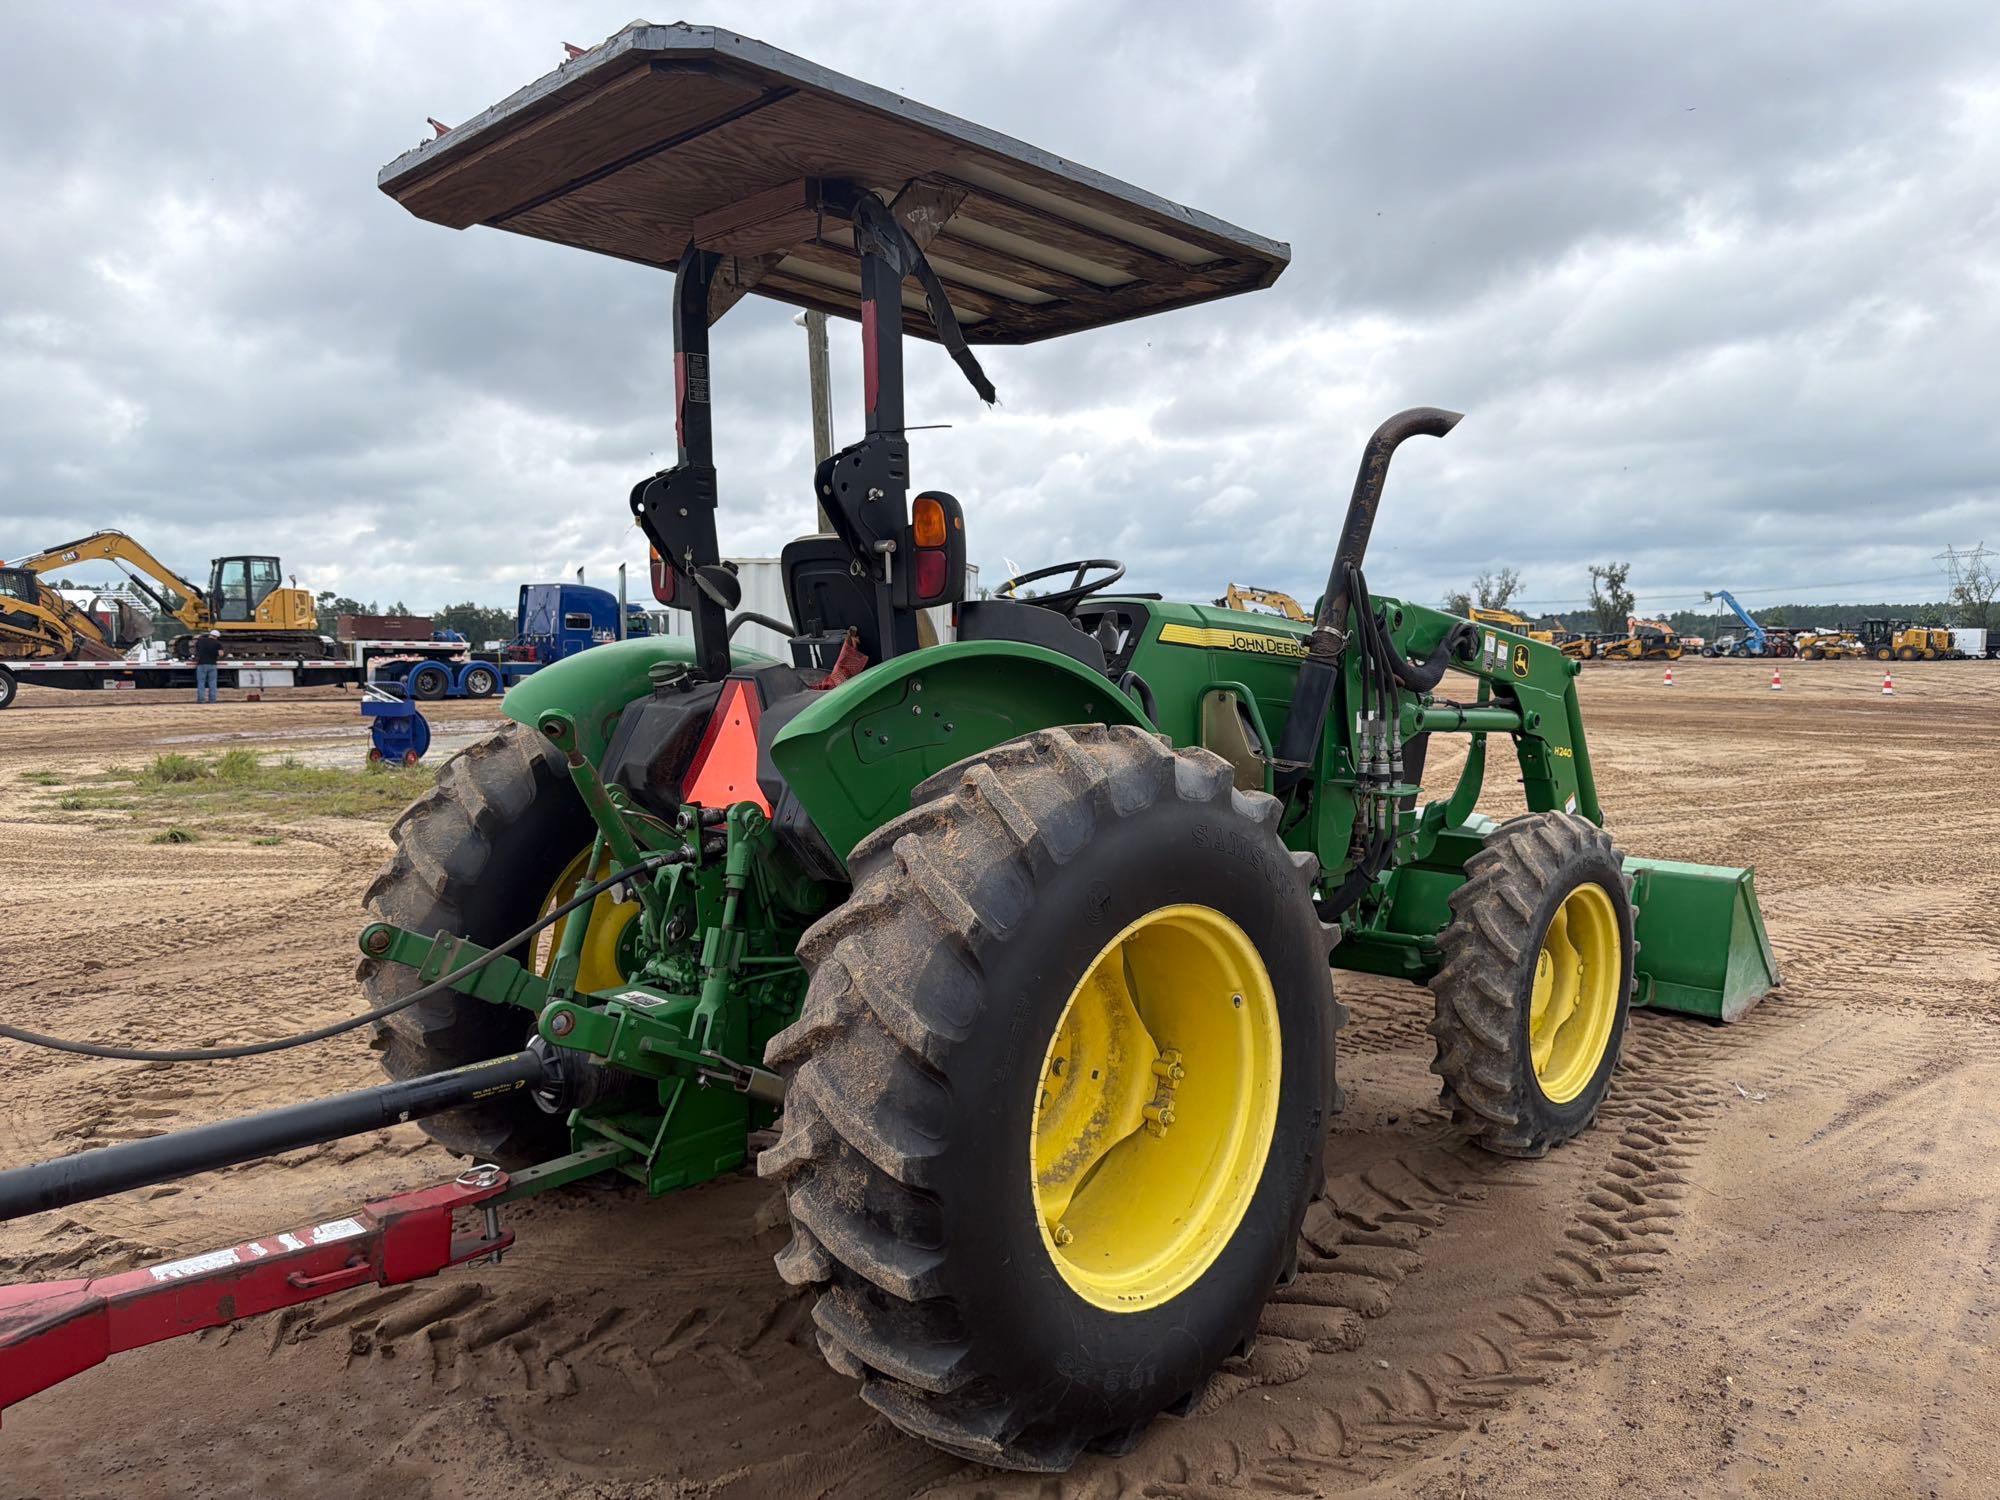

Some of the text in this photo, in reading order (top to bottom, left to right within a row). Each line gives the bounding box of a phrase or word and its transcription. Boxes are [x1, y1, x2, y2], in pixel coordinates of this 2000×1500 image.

[62, 551, 77, 562] CAT
[1229, 634, 1306, 656] JOHN DEERE
[1554, 746, 1573, 758] H240
